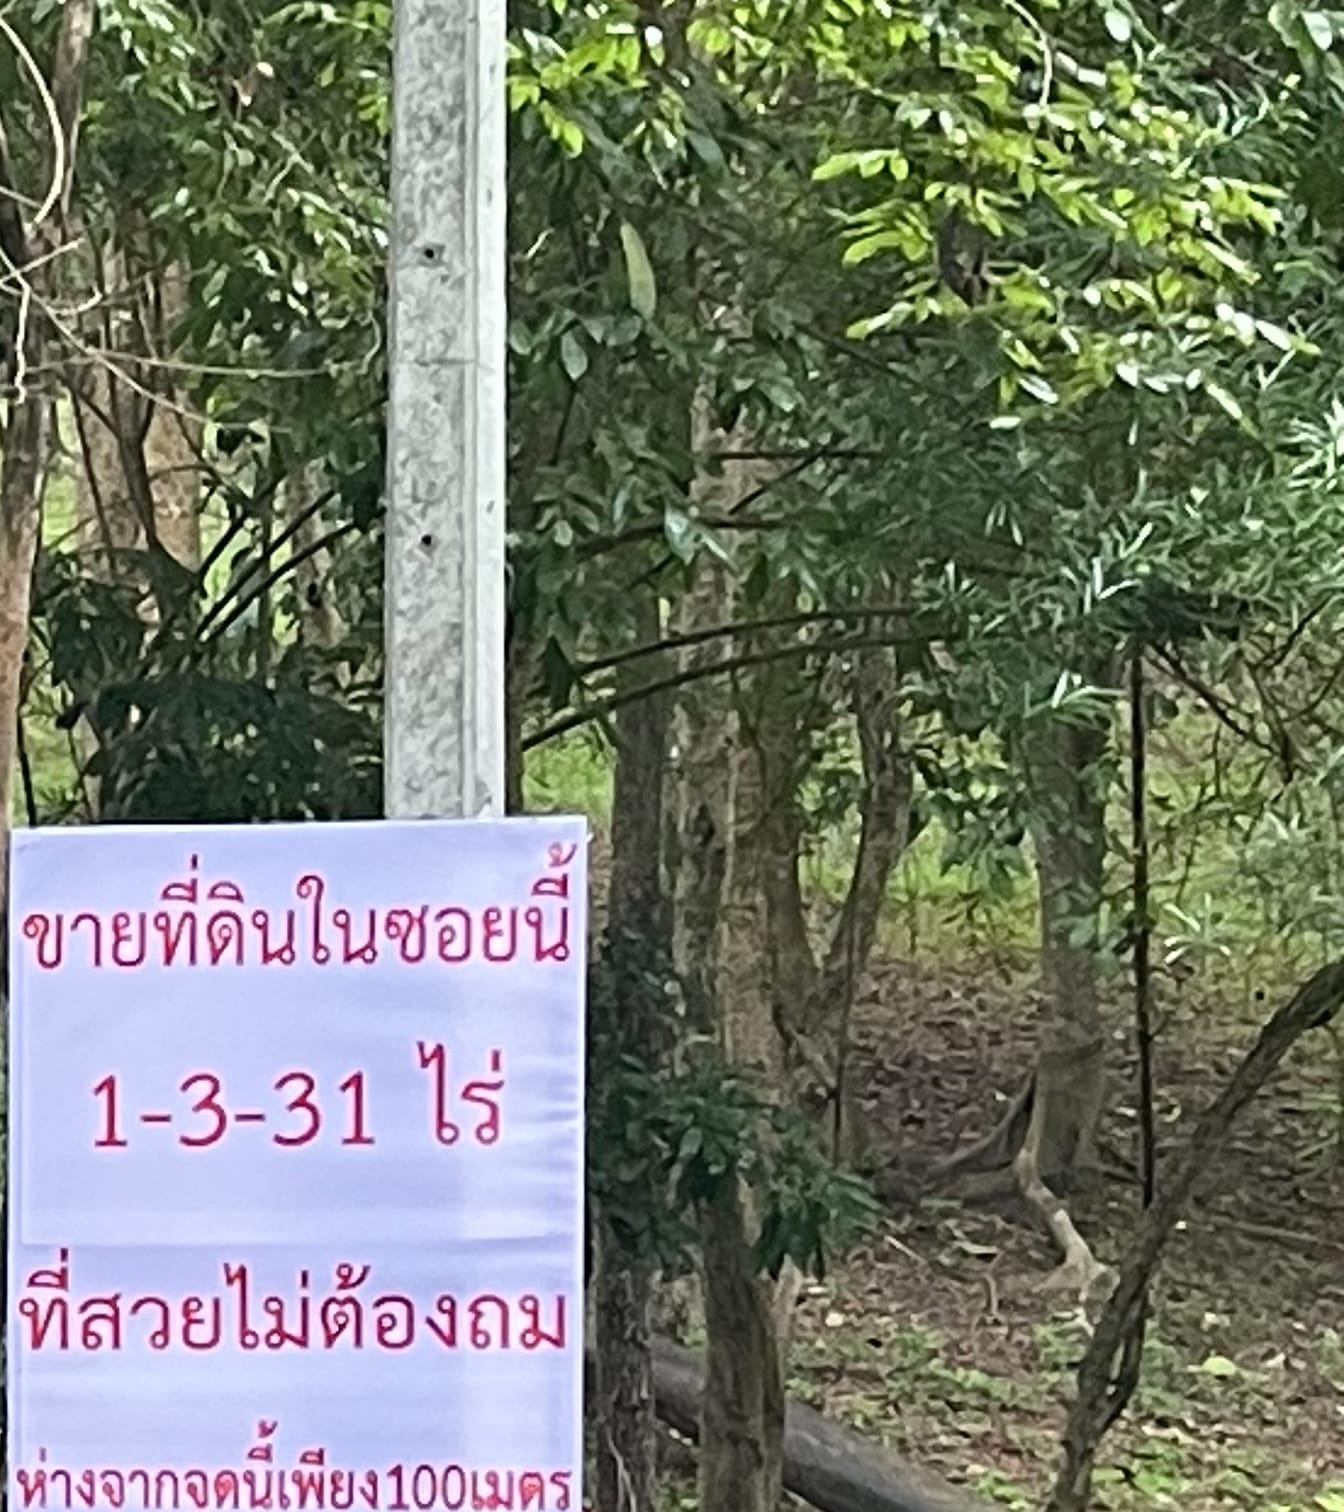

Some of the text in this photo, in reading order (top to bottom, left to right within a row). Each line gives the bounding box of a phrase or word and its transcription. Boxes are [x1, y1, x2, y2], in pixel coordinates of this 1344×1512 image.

[23, 841, 577, 968] ขายที่ดินในซอยนี้
[93, 1040, 505, 1148] 1-3-31 ไร่
[19, 1248, 566, 1350] ที่สวยไม่ต้องถม
